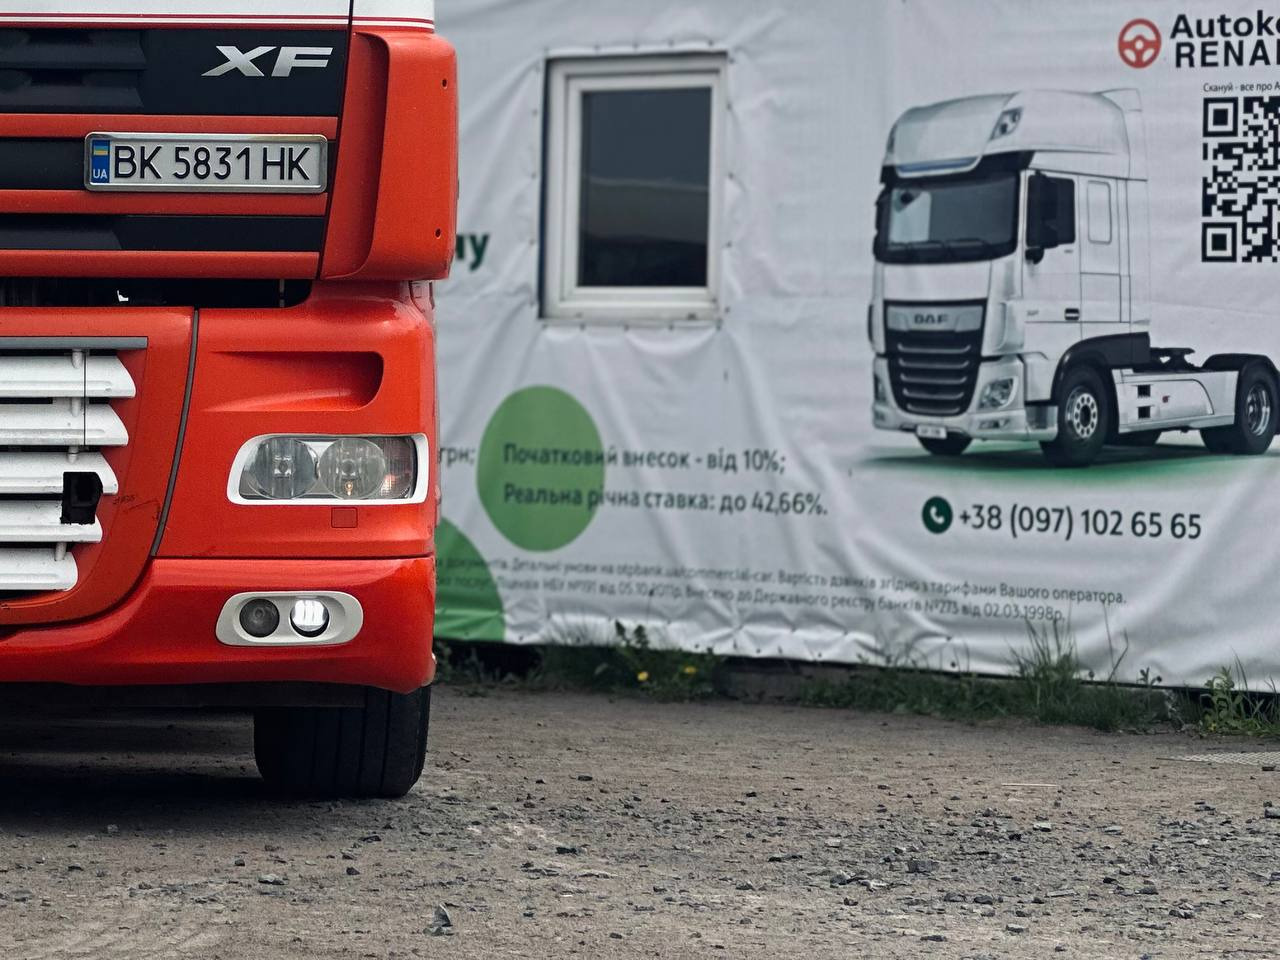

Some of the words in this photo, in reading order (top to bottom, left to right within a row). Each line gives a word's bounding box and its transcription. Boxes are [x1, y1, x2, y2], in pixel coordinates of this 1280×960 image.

[1170, 9, 1280, 39] Autok
[200, 45, 333, 78] XF
[1175, 39, 1280, 68] RENA
[1256, 83, 1272, 93] про
[93, 169, 108, 179] UA
[114, 145, 162, 179] BK
[172, 146, 250, 180] 5831
[262, 147, 310, 180] HK
[914, 314, 949, 325] DAF
[504, 443, 617, 467] Початковий
[623, 450, 690, 469] внесок
[707, 448, 737, 473] від
[743, 449, 786, 474] 10%;
[504, 483, 582, 505] Реальна
[587, 484, 639, 511] річна
[644, 492, 715, 510] ставка:
[720, 495, 747, 515] до
[752, 492, 828, 516] 42,66%.
[959, 504, 1002, 531] +38
[1010, 504, 1074, 540] (097)
[1081, 509, 1123, 537] 102
[1131, 511, 1162, 538] 65
[1170, 513, 1202, 540] 65
[1000, 582, 1049, 599] Вашого
[1053, 587, 1127, 605] оператора.
